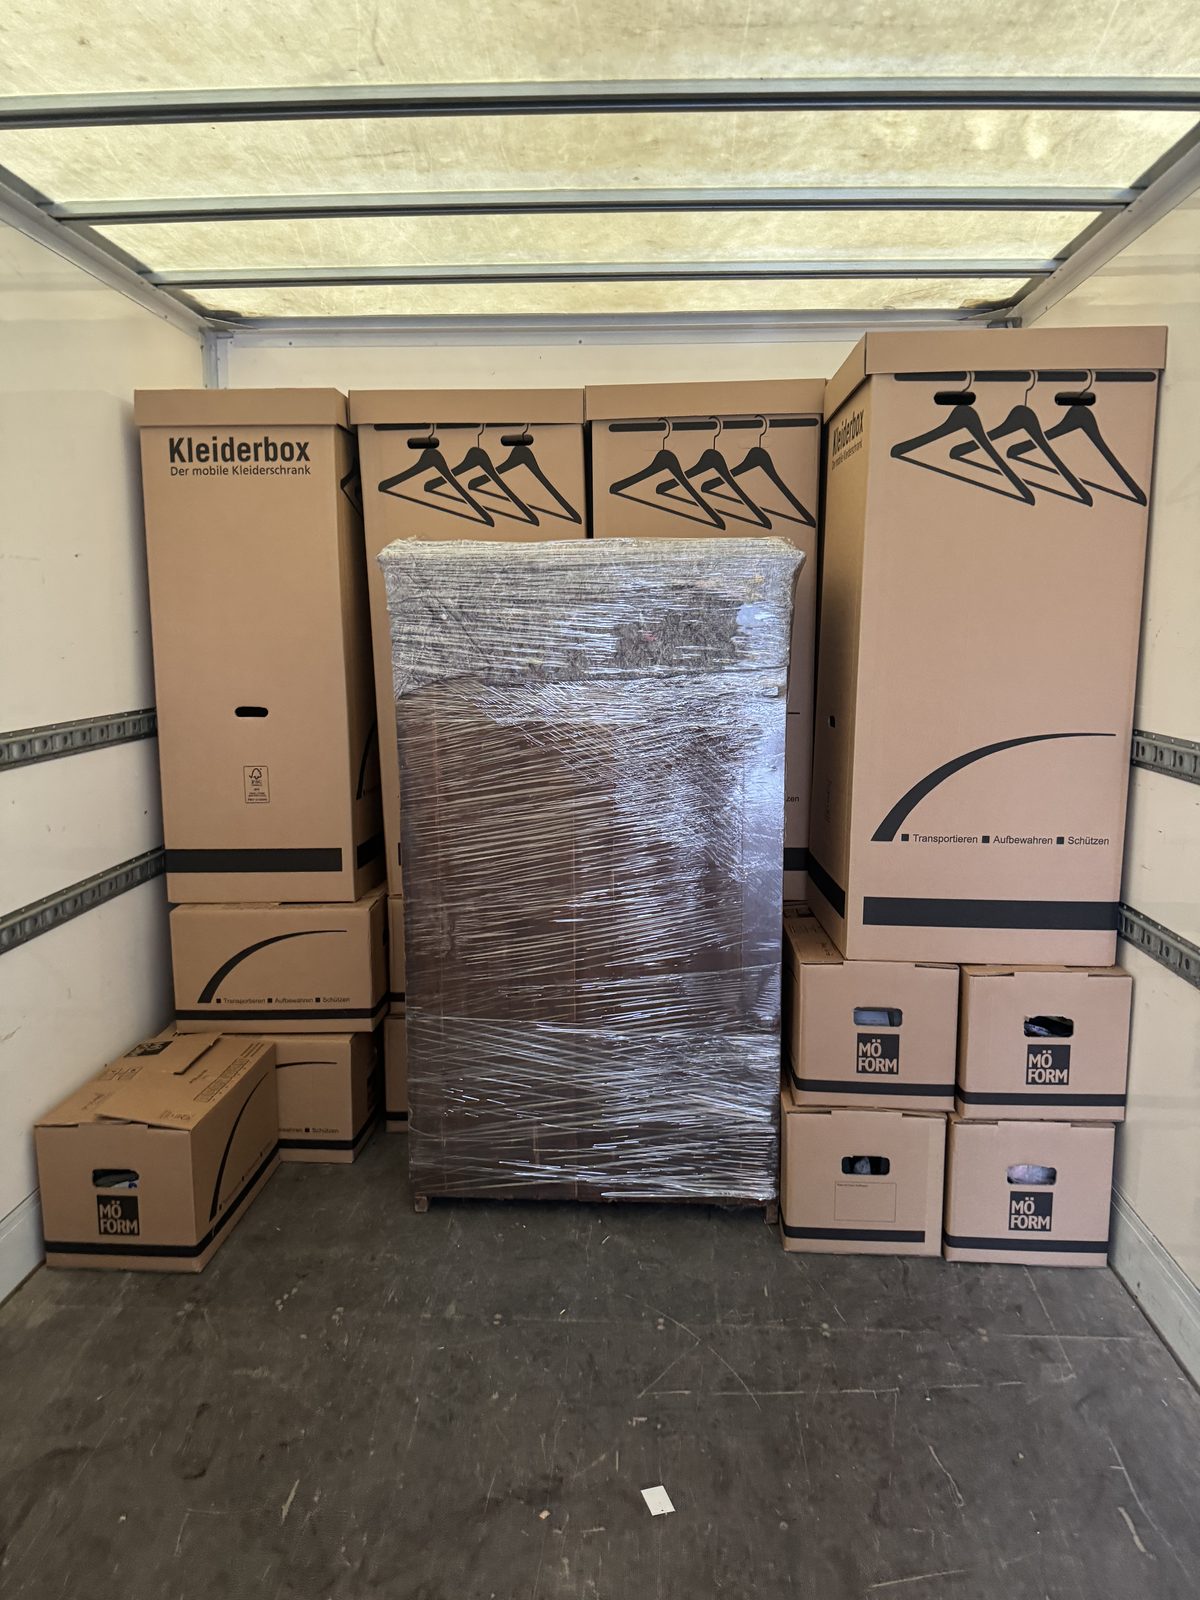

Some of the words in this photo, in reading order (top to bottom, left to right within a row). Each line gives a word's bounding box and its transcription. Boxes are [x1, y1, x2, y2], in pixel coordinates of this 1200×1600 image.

[168, 436, 311, 463] Kleiderbox
[170, 466, 189, 476] Der
[192, 465, 229, 476] mobile
[232, 464, 311, 476] Kleiderschrank
[913, 833, 978, 845] Transportieren
[993, 835, 1053, 845] Aufbewahren
[1067, 836, 1110, 846] Schützen
[858, 1039, 882, 1057] MÖ
[858, 1057, 898, 1073] FORM
[1028, 1050, 1053, 1068] MÖ
[1027, 1069, 1068, 1083] FORM
[99, 1200, 122, 1219] MÖ
[1011, 1196, 1035, 1215] MÖ
[100, 1219, 139, 1234] FORM
[1010, 1214, 1051, 1230] FORM
